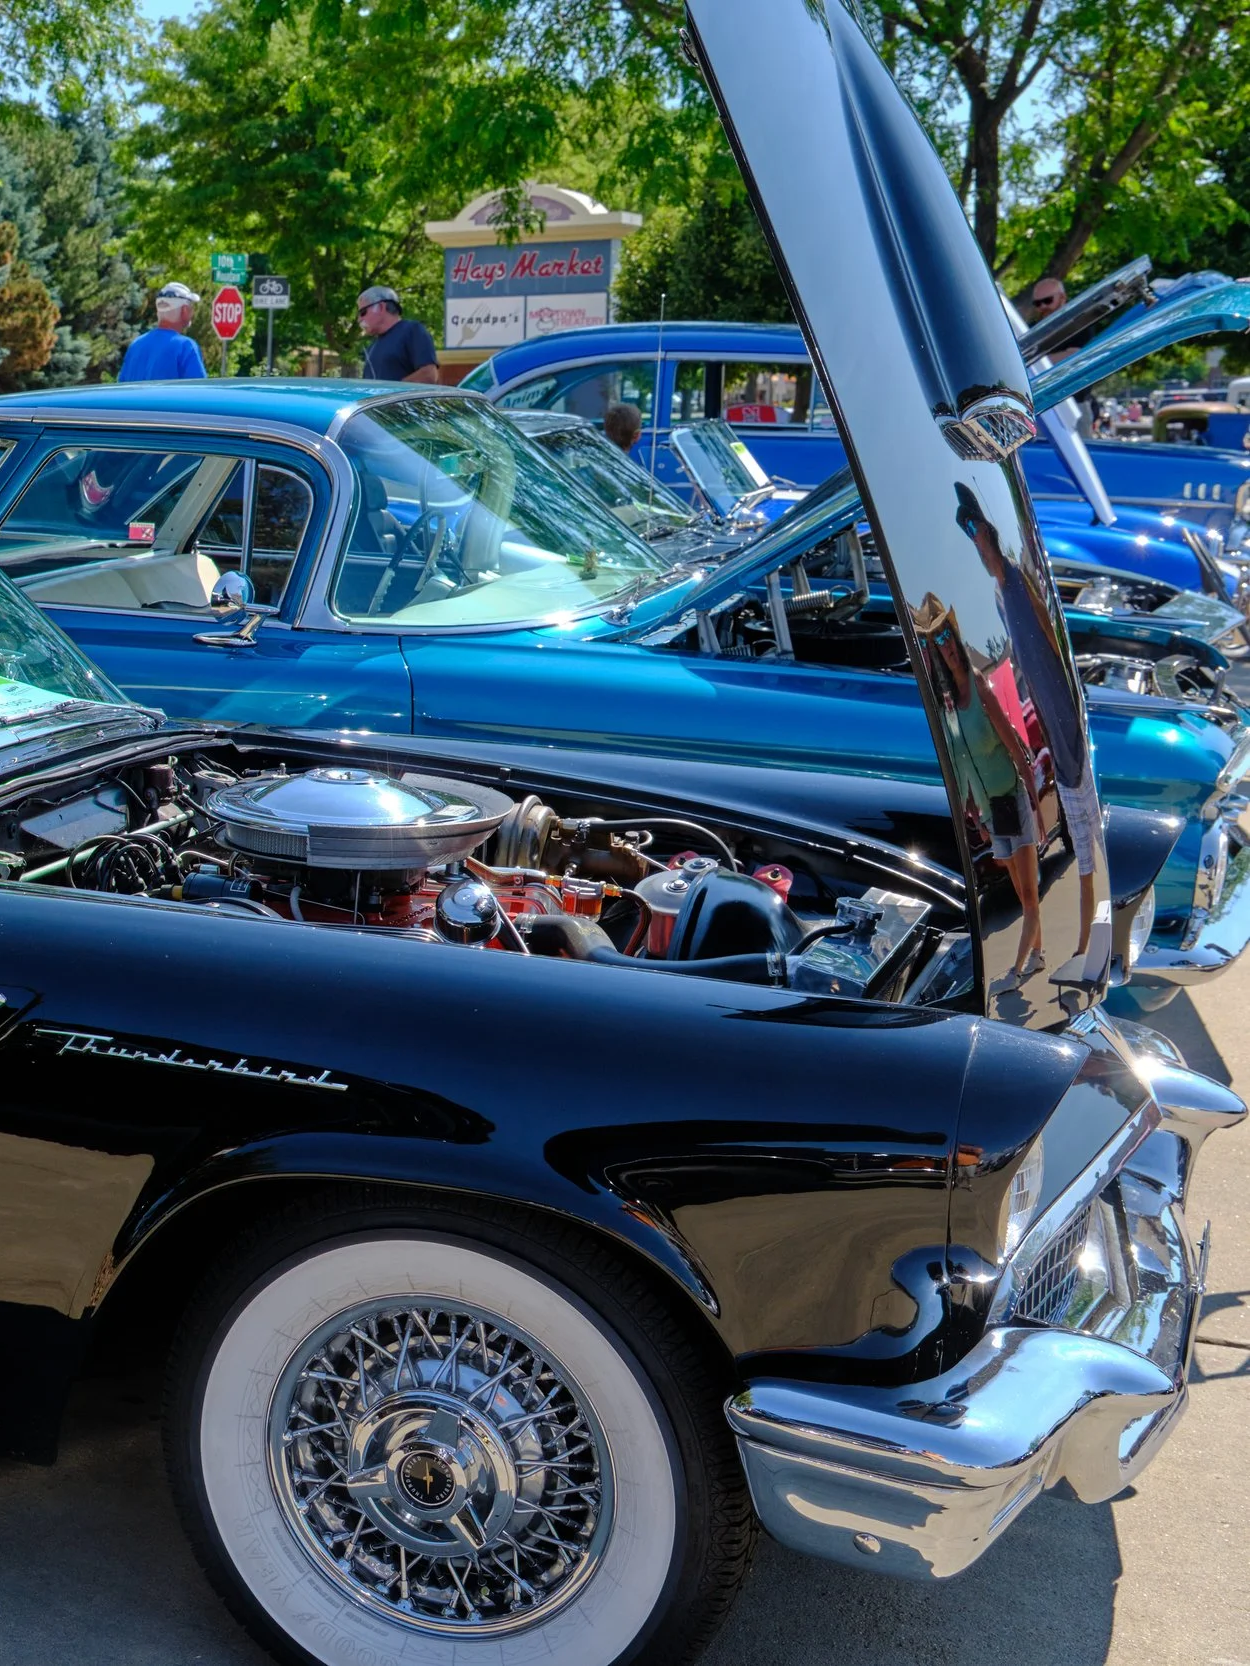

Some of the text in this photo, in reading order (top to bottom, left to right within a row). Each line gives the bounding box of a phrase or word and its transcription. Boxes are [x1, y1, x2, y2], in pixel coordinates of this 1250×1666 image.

[217, 255, 234, 268] 10th
[452, 248, 604, 289] Hays Market
[214, 303, 242, 323] STOP
[451, 312, 519, 326] Grandpa's
[36, 1028, 348, 1091] Thunderbird
[404, 1456, 424, 1500] THUNDERBIRD
[433, 1456, 453, 1501] THUNDERBIRD
